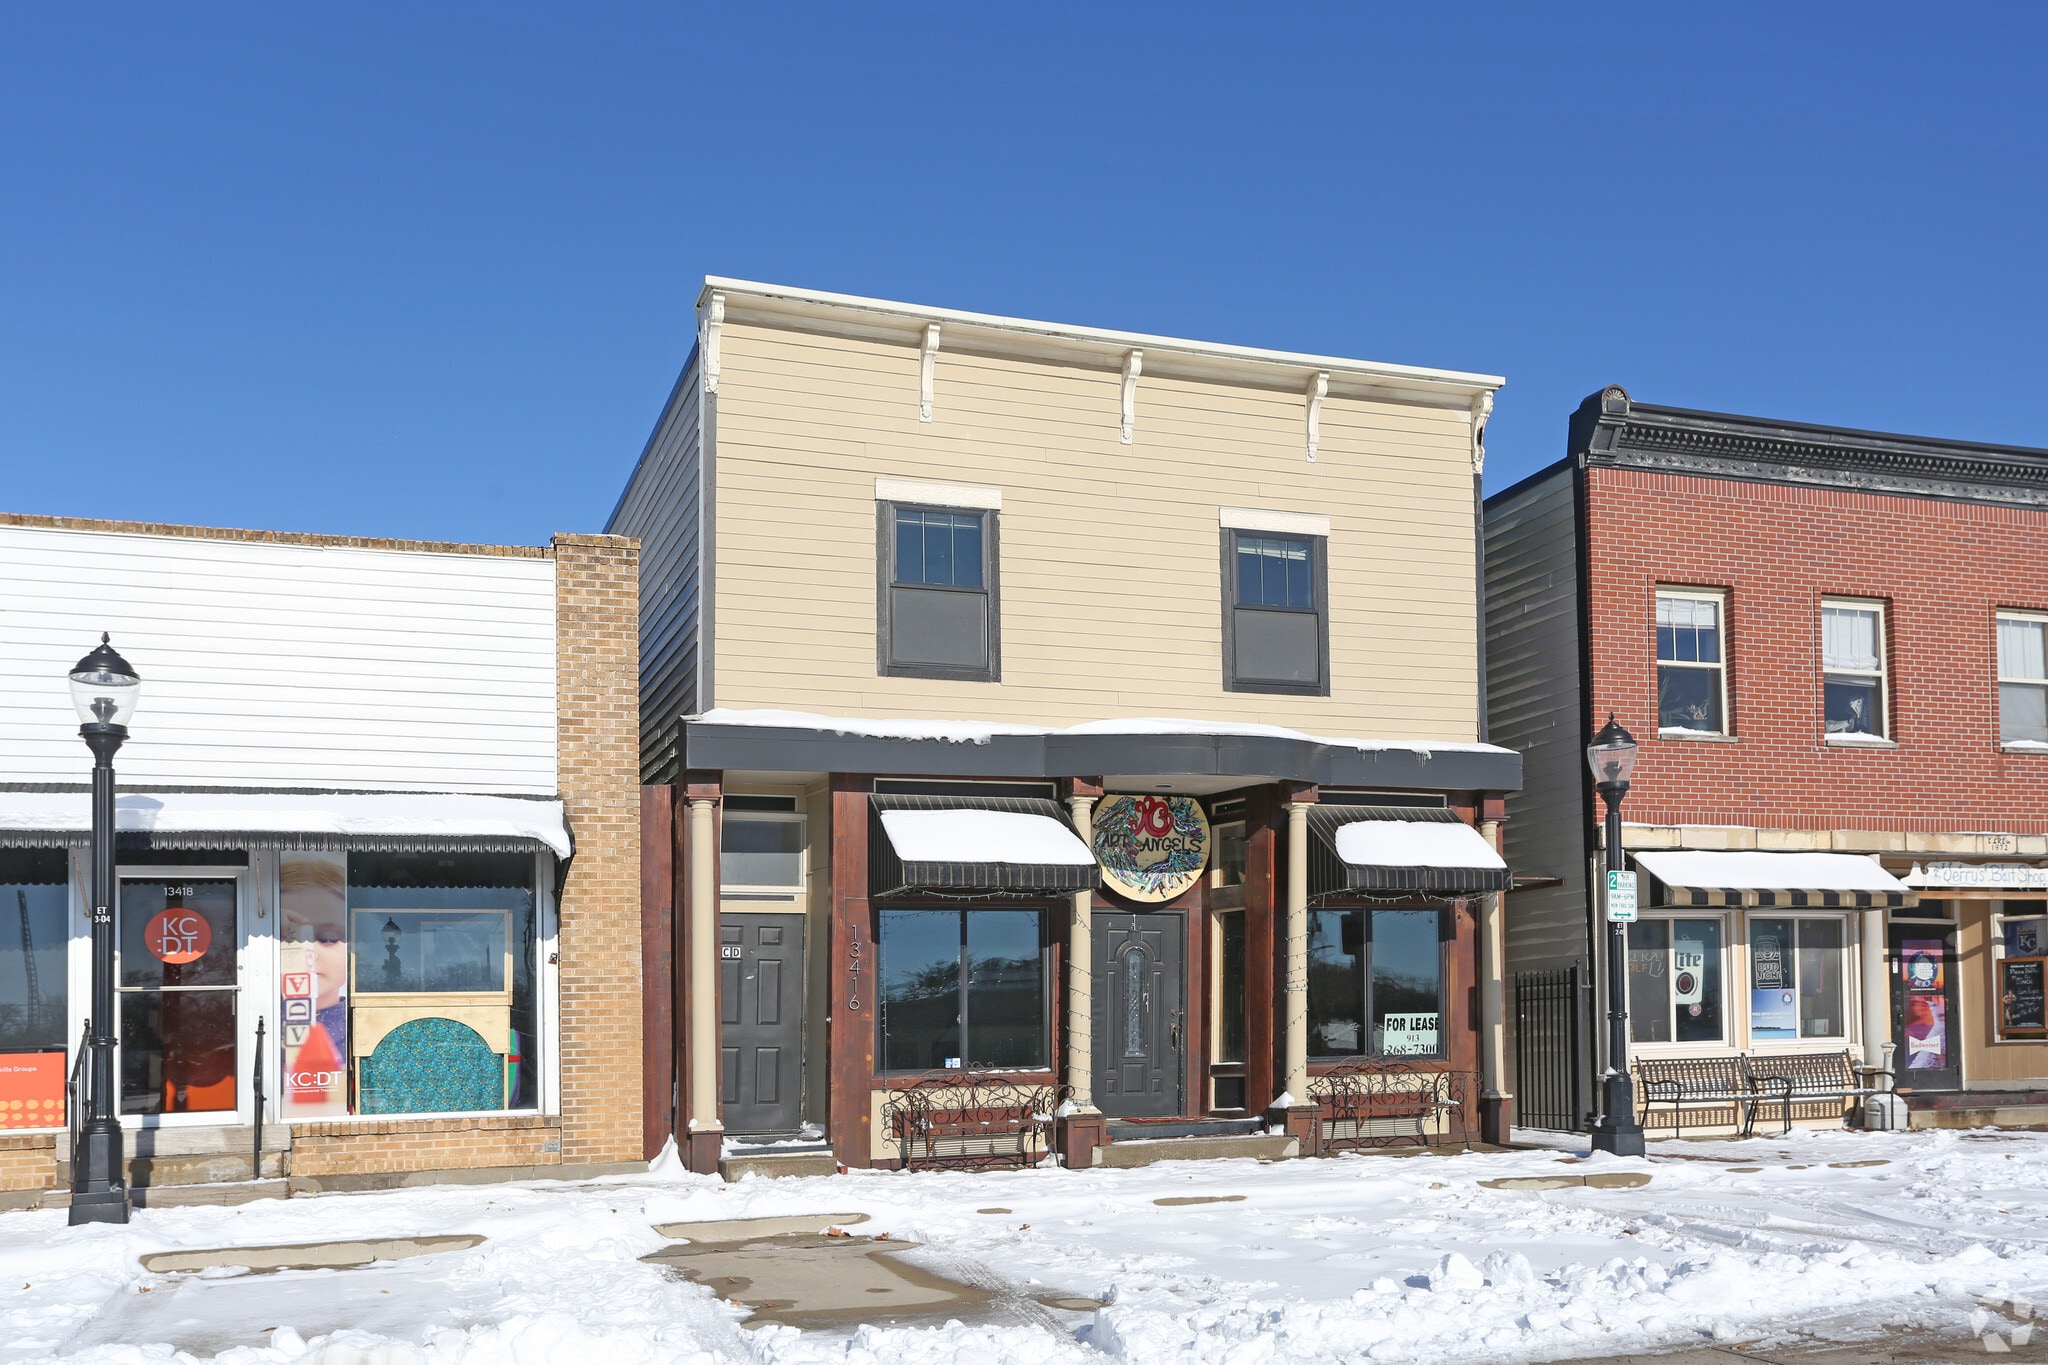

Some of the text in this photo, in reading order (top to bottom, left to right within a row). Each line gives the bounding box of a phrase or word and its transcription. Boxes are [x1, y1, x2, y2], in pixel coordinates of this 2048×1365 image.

[1139, 837, 1202, 852] ANGELS
[1610, 875, 1617, 887] 2
[163, 887, 194, 896] 13418
[94, 915, 111, 923] 3-04
[162, 917, 198, 936] KC
[1758, 963, 1780, 971] BUD
[1386, 1017, 1439, 1031] FOR LEASE
[1406, 1034, 1420, 1042] 913
[1386, 1044, 1438, 1055] 268-7300
[286, 1071, 342, 1087] KC:DT
